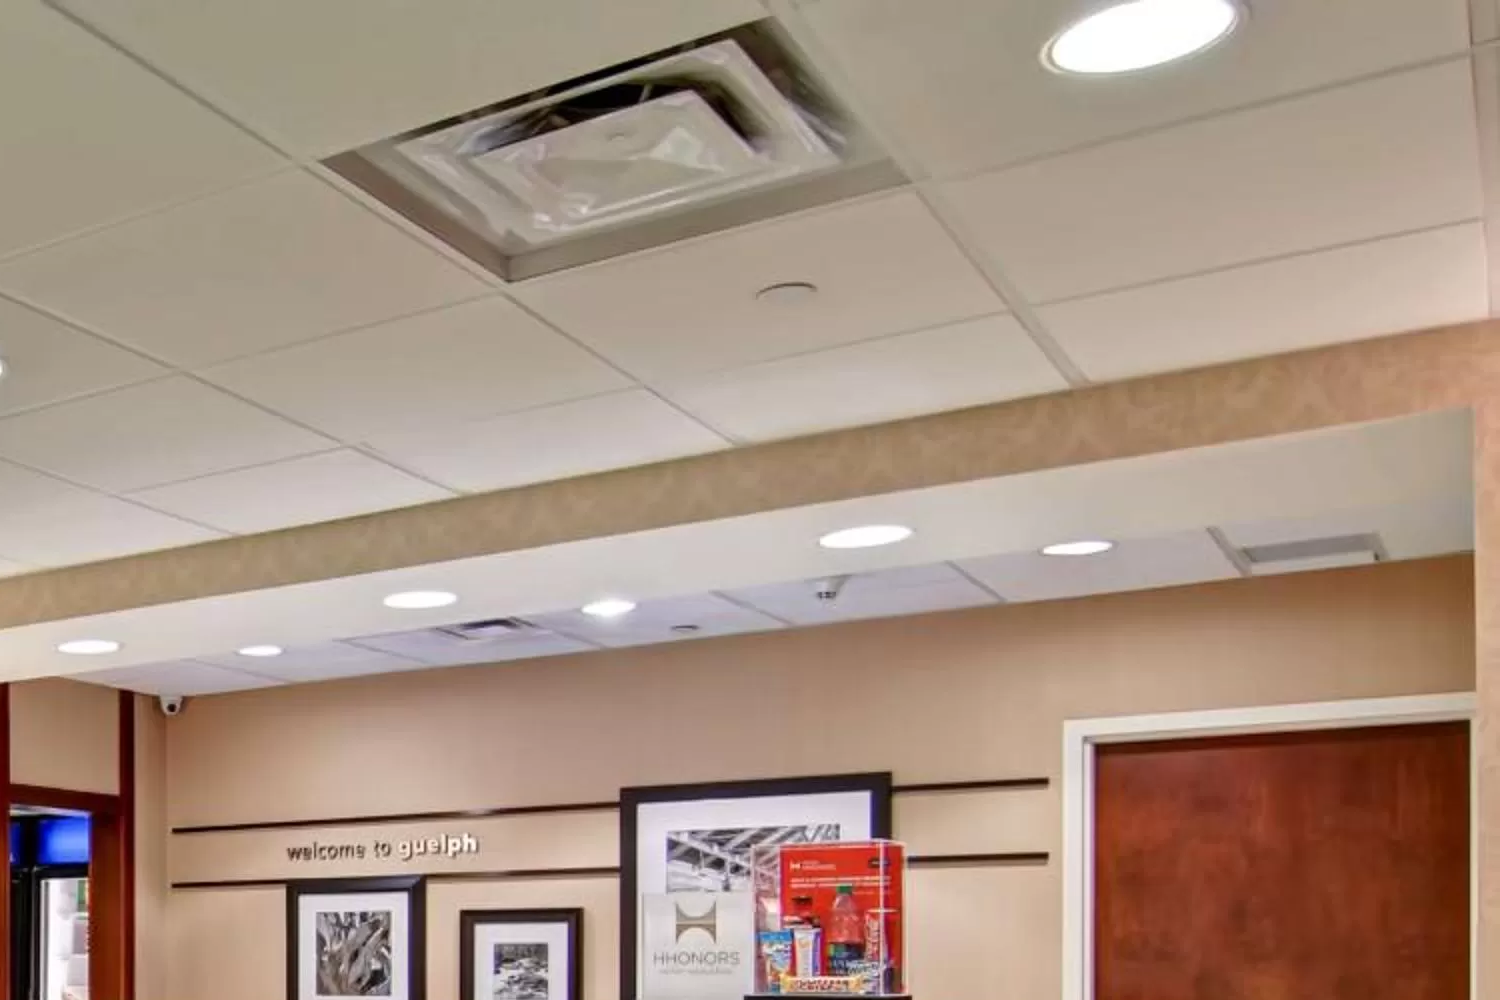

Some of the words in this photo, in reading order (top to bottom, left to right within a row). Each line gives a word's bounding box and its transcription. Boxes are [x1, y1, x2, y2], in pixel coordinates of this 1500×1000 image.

[287, 842, 366, 861] welcome
[374, 840, 392, 858] to
[399, 832, 479, 862] guelph
[652, 951, 741, 966] HHONORS
